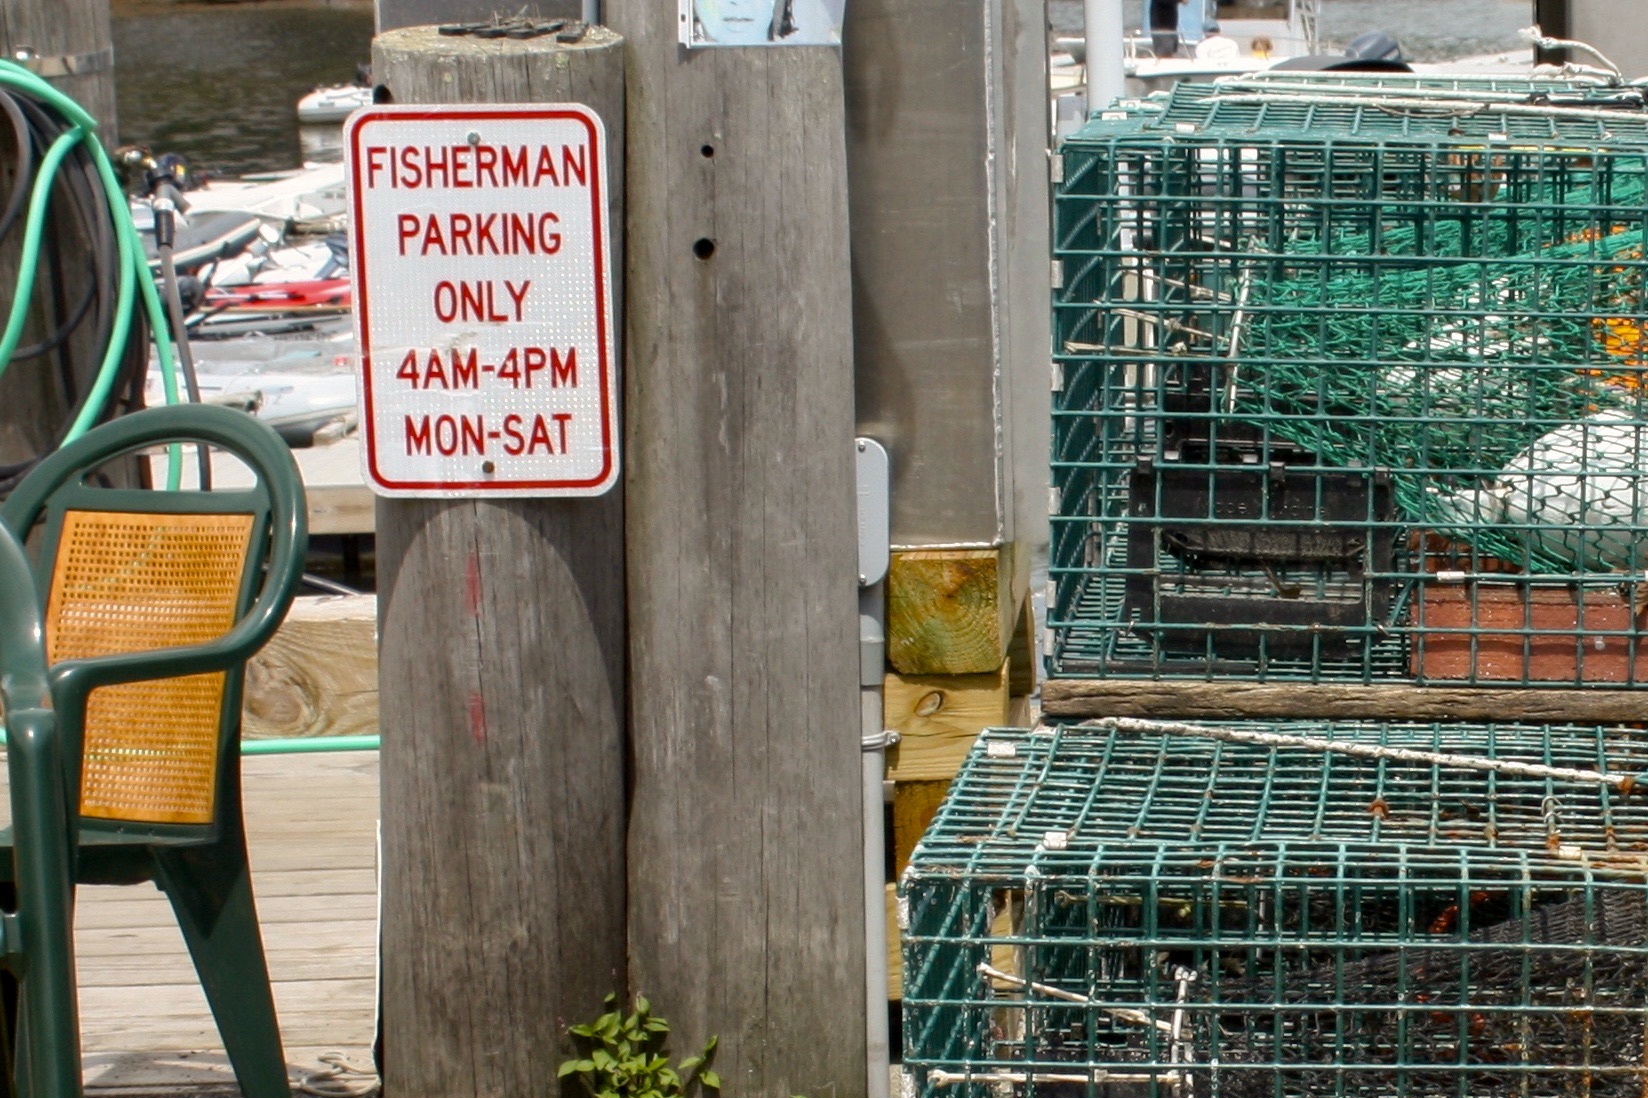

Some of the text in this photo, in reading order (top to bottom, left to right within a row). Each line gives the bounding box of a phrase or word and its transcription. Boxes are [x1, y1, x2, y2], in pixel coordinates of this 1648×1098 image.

[368, 145, 587, 189] FISHERMAN
[399, 213, 561, 254] PARKING
[436, 281, 529, 323] ONLY
[398, 347, 577, 387] 4AM-4PM
[406, 413, 572, 456] MON-SAT
